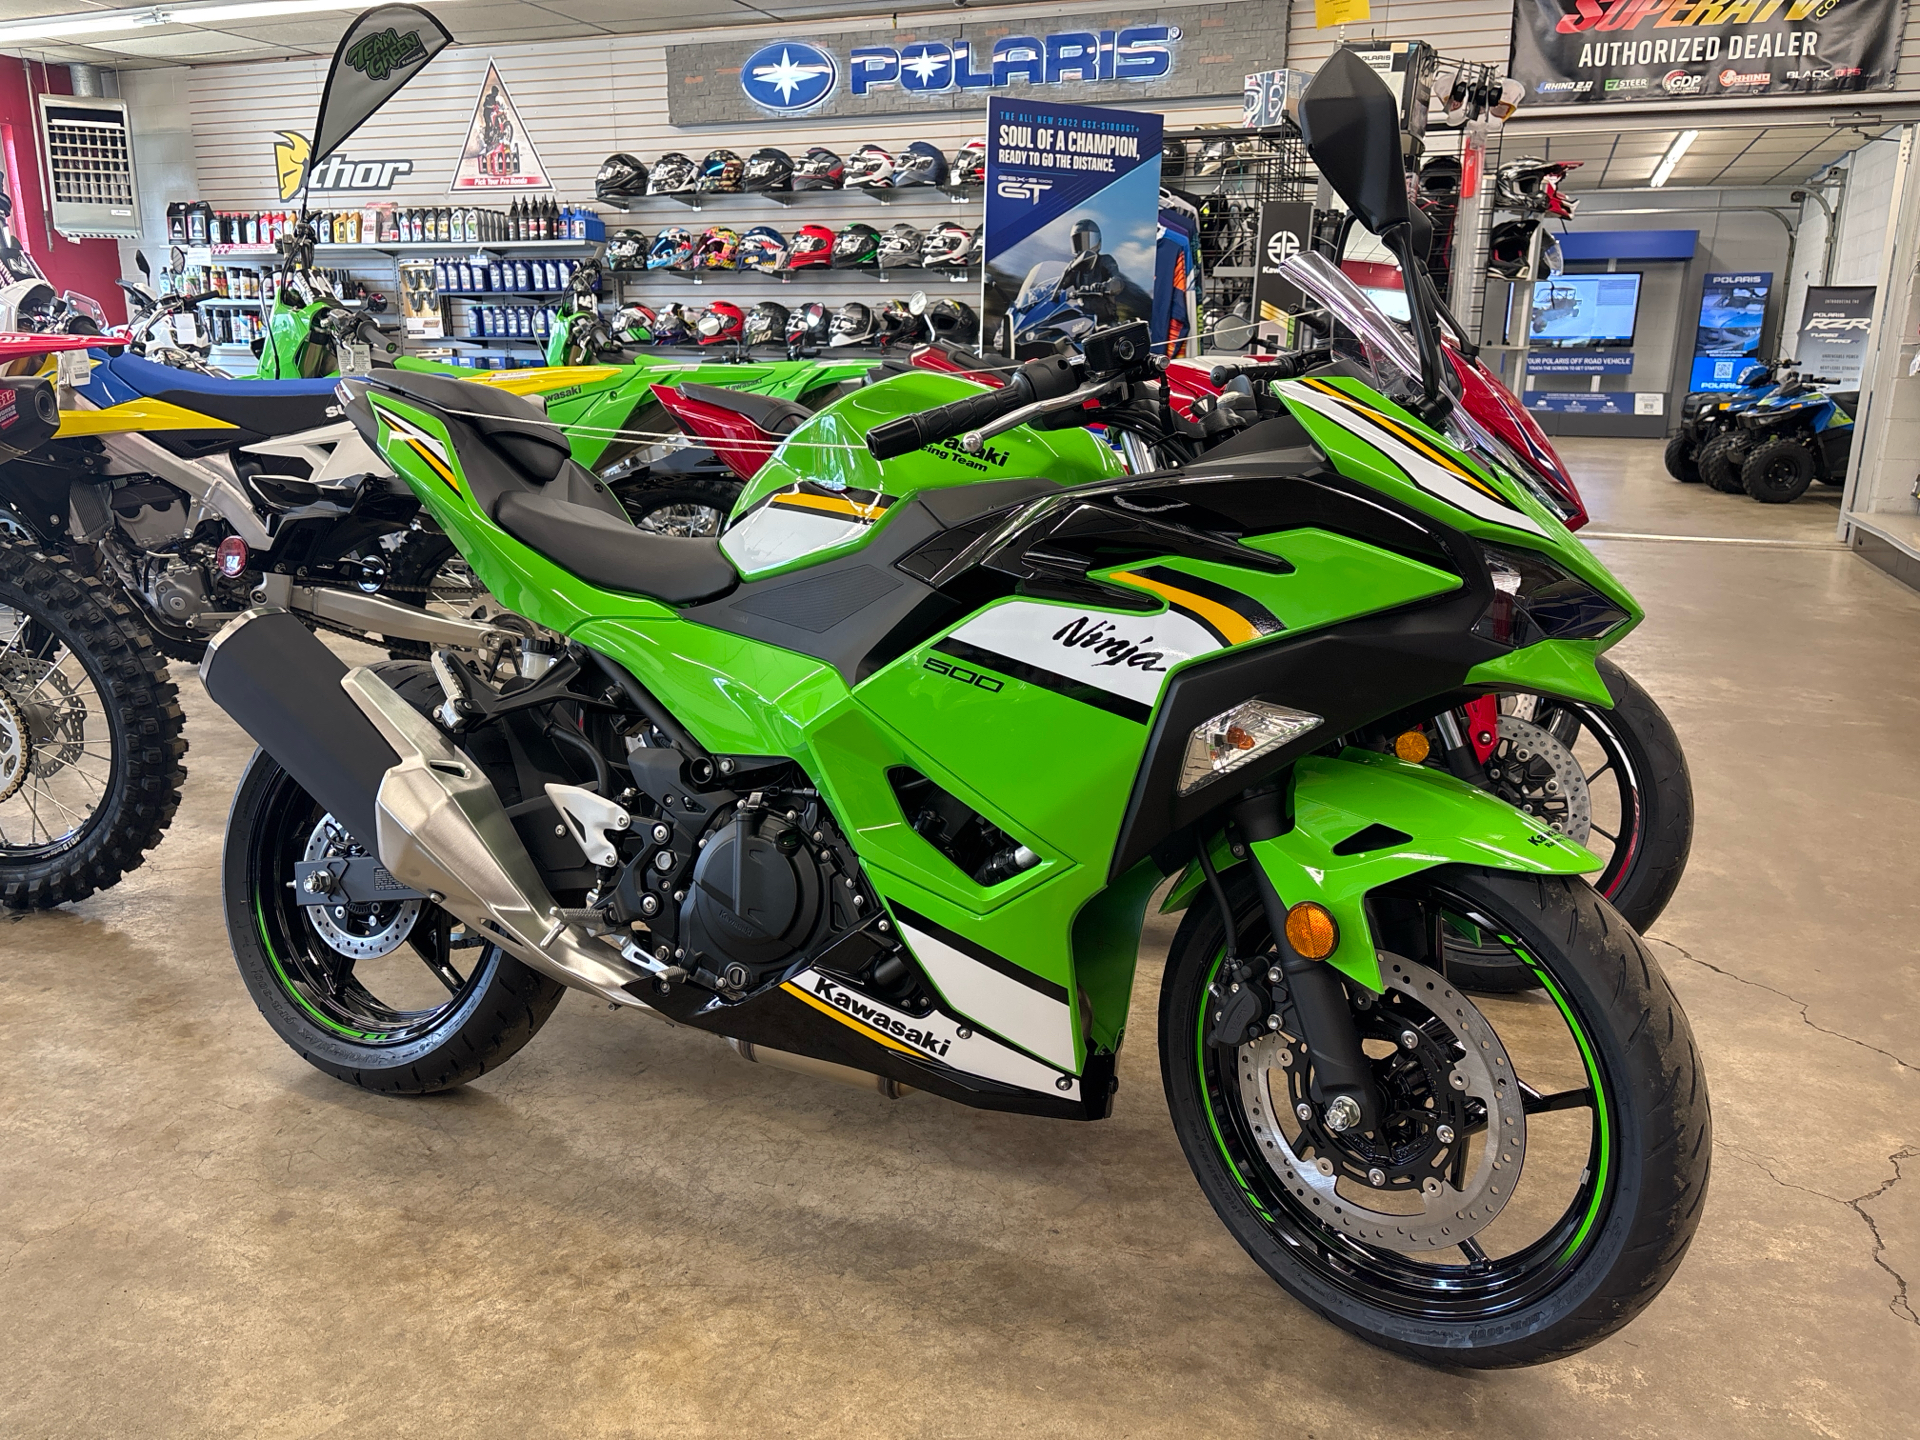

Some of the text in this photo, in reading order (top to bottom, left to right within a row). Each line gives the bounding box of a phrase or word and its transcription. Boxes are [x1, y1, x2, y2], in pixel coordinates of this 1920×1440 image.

[348, 31, 397, 68] TEAM
[368, 34, 418, 78] GREEN
[850, 27, 1172, 95] POLARIS
[1578, 31, 1818, 68] AUTHORIZED DEALER
[1604, 79, 1620, 91] EZ
[1619, 79, 1648, 88] STEER
[1670, 75, 1702, 88] GDP
[1733, 73, 1771, 83] RHINO
[1786, 69, 1831, 80] BLACK
[1544, 83, 1574, 91] RHINO
[1000, 111, 1015, 121] THE
[1018, 113, 1033, 123] ALL
[1037, 115, 1054, 125] NEW
[1057, 117, 1078, 128] 2022
[999, 124, 1141, 161] SOUL OF A CHAMPION,
[309, 155, 410, 189] thor
[999, 149, 1116, 173] READY TO GO THE DISTANCE.
[997, 182, 1053, 206] GT
[1713, 275, 1762, 284] POLARIS
[1541, 357, 1569, 365] POLARIS
[1570, 357, 1583, 365] OFF
[1583, 357, 1602, 365] ROAD
[1602, 357, 1631, 365] VEHICLE
[544, 384, 582, 403] wasaki
[1701, 382, 1743, 390] POLARIS
[921, 444, 988, 472] cing Team
[1052, 616, 1167, 672] Ninja
[923, 657, 1005, 693] 500
[719, 909, 754, 938] Kawasaki
[813, 976, 951, 1058] Kawasaki
